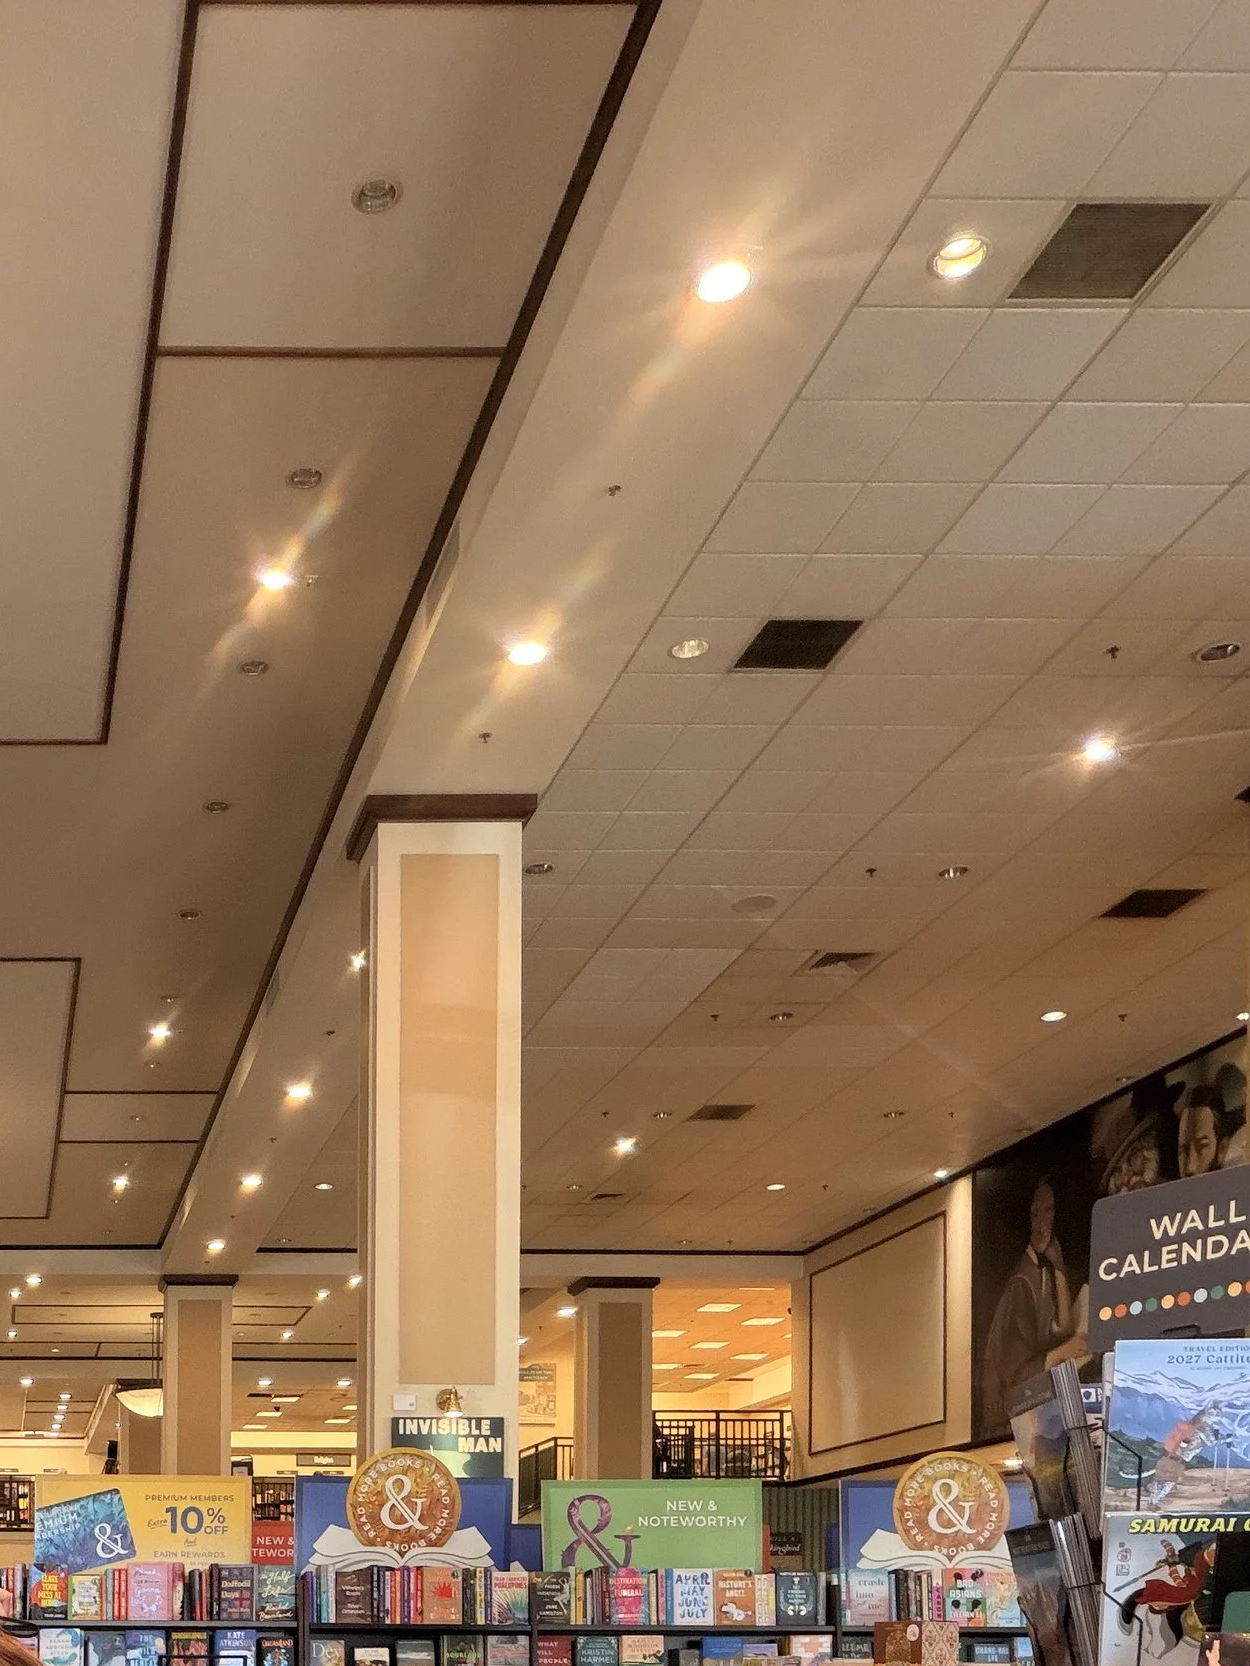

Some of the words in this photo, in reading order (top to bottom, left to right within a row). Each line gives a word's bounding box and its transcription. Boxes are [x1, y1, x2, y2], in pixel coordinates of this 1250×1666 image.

[1150, 1200, 1248, 1241] WALL
[1167, 1355, 1201, 1364] 2027
[398, 1419, 491, 1436] INVISIBLE
[458, 1437, 502, 1453] MAN
[431, 1472, 450, 1504] READ
[979, 1476, 998, 1508] READ
[145, 1494, 187, 1502] PREMIUM
[191, 1494, 234, 1502] MEMBERS
[357, 1506, 376, 1538] READ
[380, 1456, 421, 1472] BOOKS
[904, 1512, 924, 1543] READ
[926, 1462, 968, 1477] BOOKS
[667, 1500, 703, 1512] NEW
[707, 1500, 718, 1512] &
[147, 1519, 167, 1527] Extra
[429, 1509, 450, 1541] MORE
[638, 1516, 747, 1527] NOTEWORTHY
[1129, 1517, 1237, 1534] SAMURAI
[204, 1525, 228, 1535] OFF
[979, 1512, 998, 1545] MORE
[256, 1536, 284, 1546] NEW
[153, 1550, 178, 1558] EARN
[221, 1580, 250, 1588] Daffodil
[949, 1589, 982, 1599] ASIANS
[679, 1609, 708, 1619] JULY
